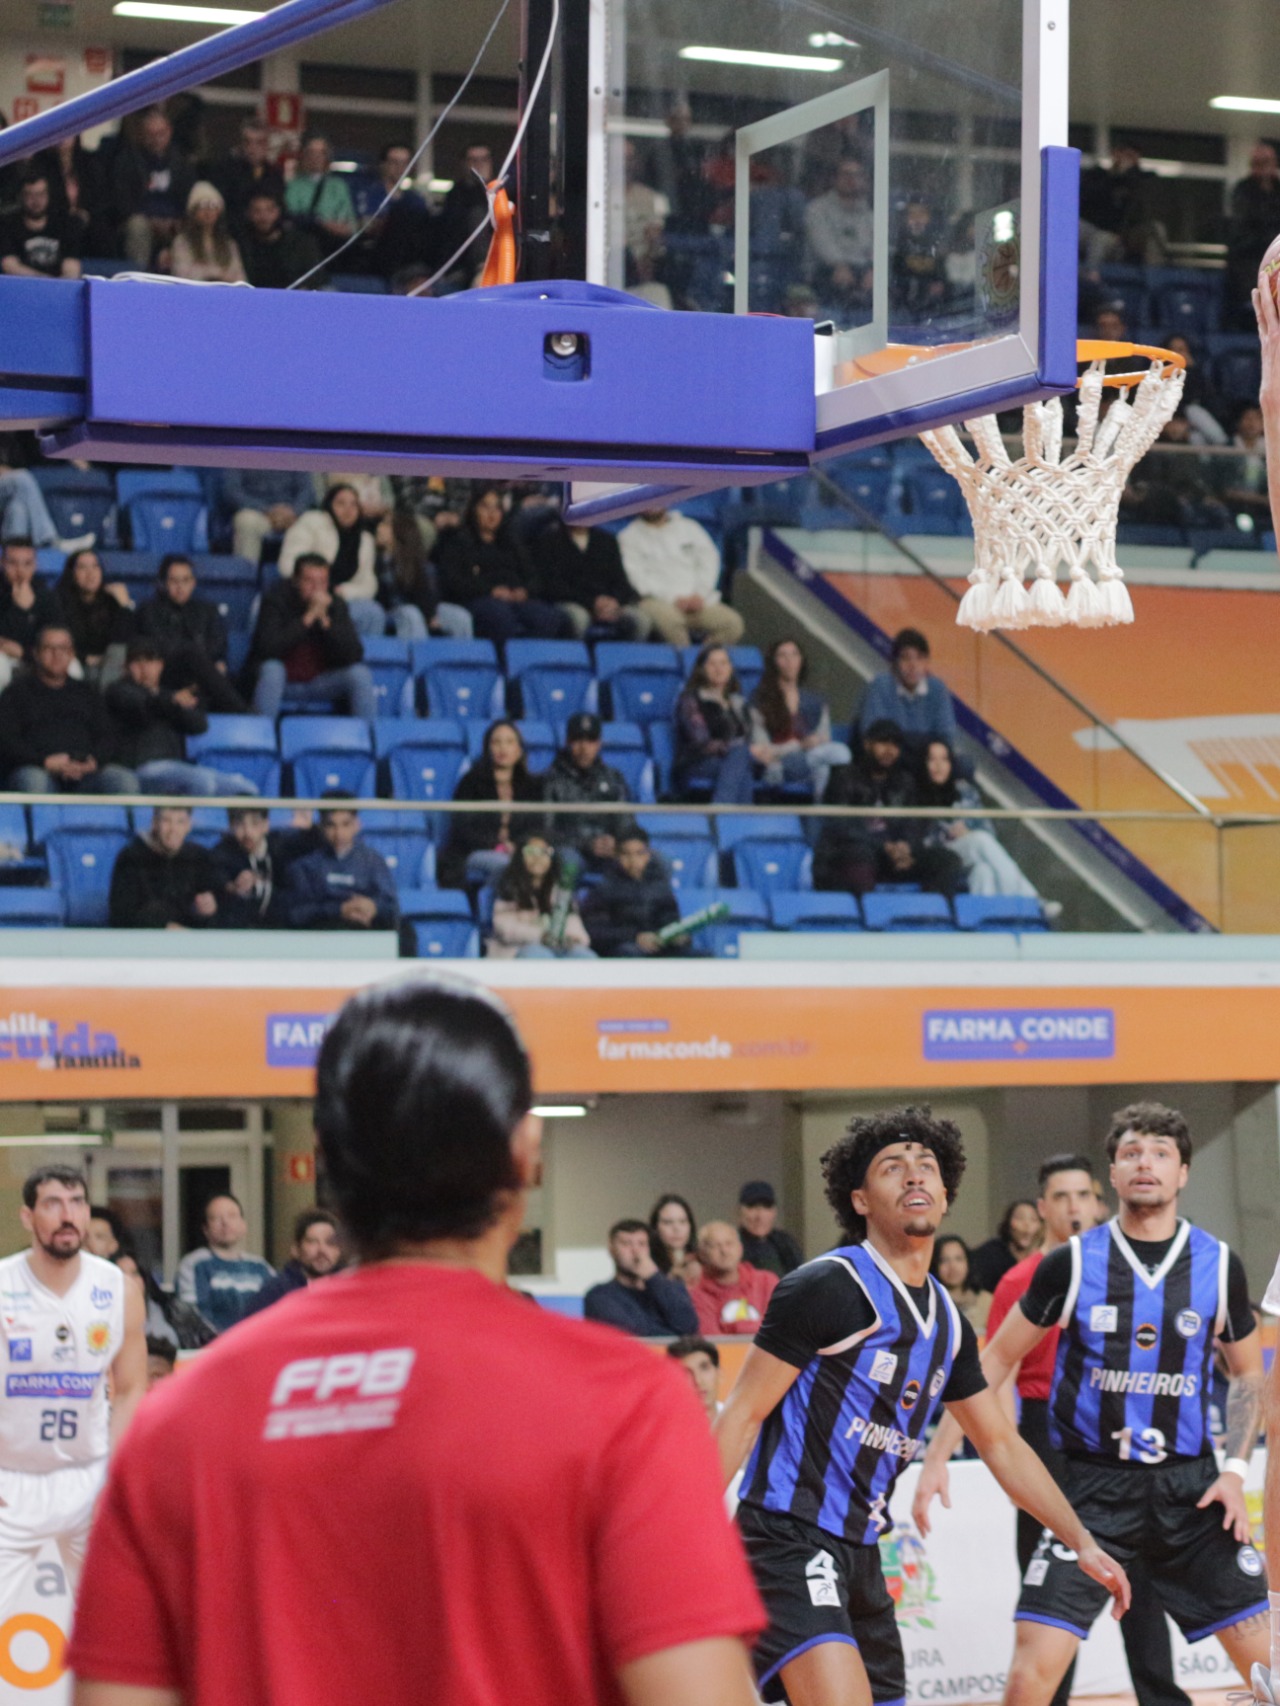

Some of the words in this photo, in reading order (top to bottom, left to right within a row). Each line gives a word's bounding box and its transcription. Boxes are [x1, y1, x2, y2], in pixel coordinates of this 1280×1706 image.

[928, 1018, 1014, 1041] FARMA
[1020, 1017, 1109, 1040] CONDE
[271, 1347, 416, 1407] FPB
[1089, 1366, 1198, 1397] PINHEIROS
[40, 1408, 78, 1442] 26
[1110, 1426, 1169, 1465] 13
